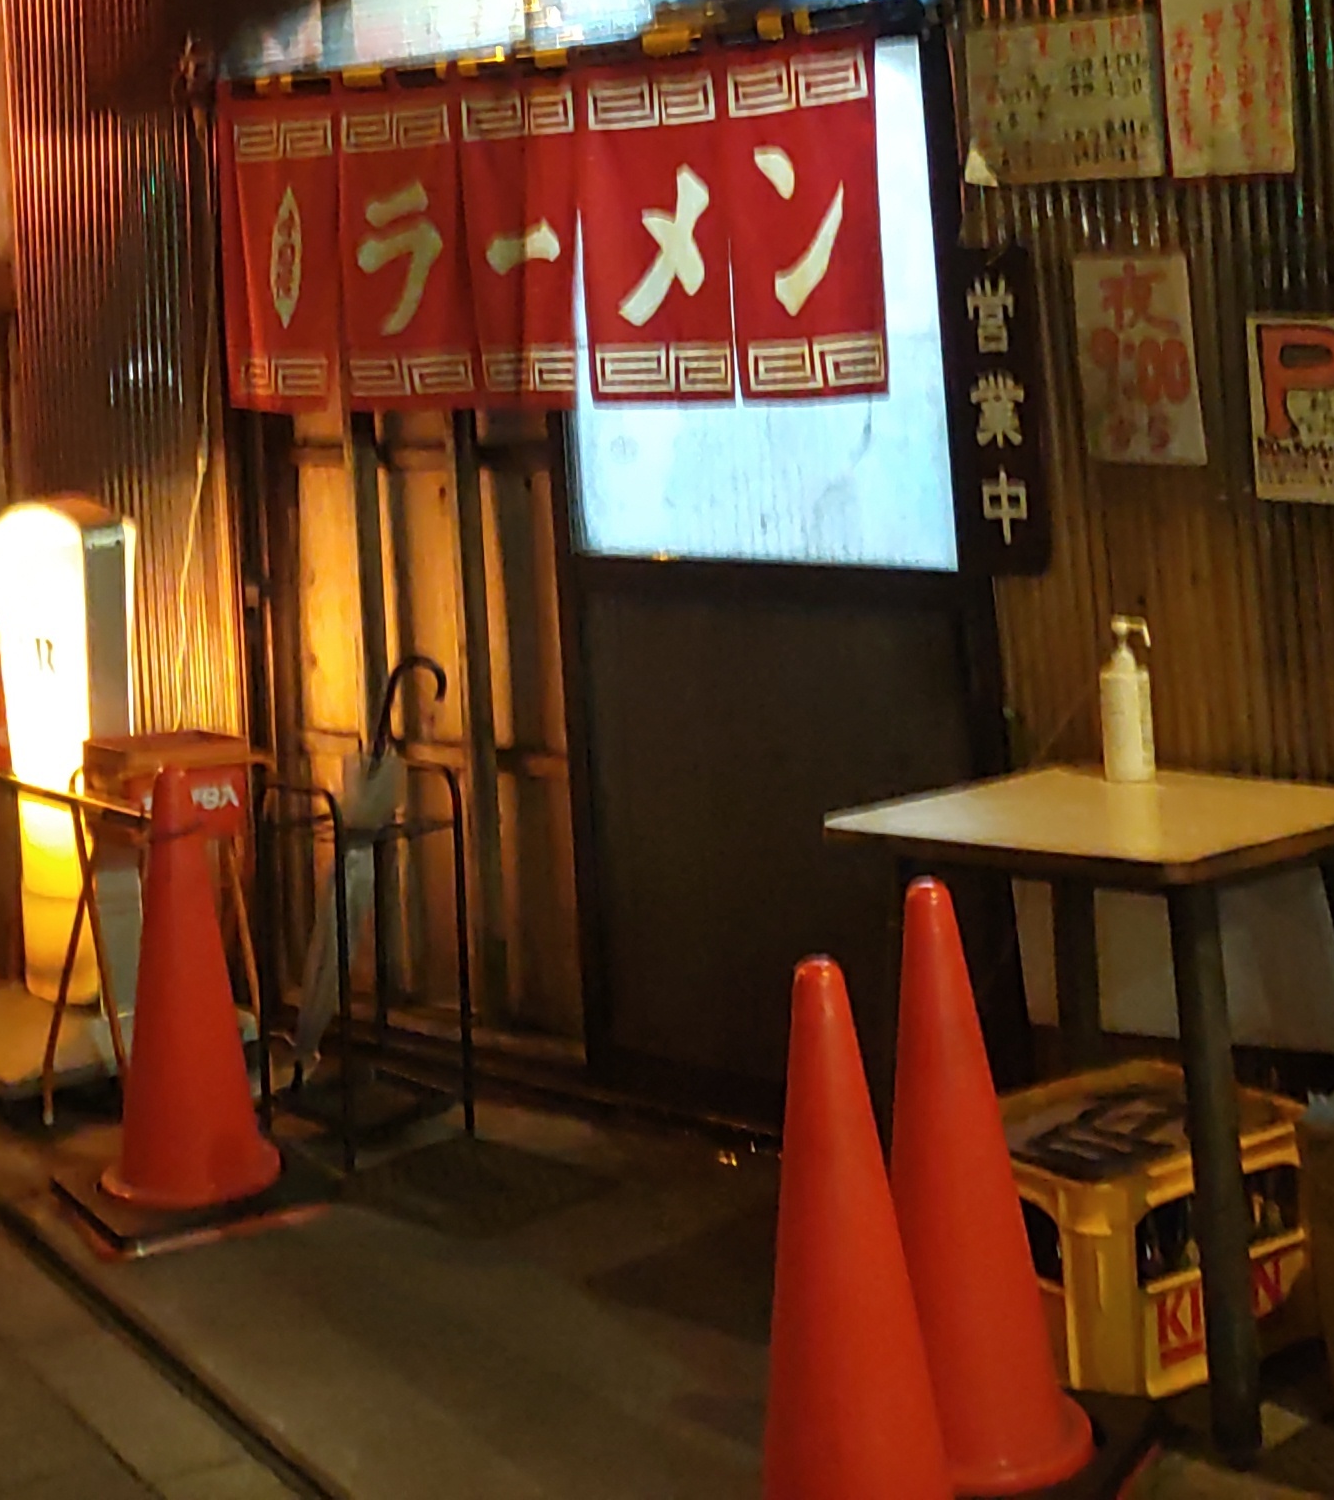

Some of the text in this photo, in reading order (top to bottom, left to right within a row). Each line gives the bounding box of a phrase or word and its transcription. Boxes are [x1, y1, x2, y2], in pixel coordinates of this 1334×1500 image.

[356, 144, 845, 338] ラーメン
[966, 272, 1029, 546] 営業中
[1154, 1256, 1285, 1348] KIN
